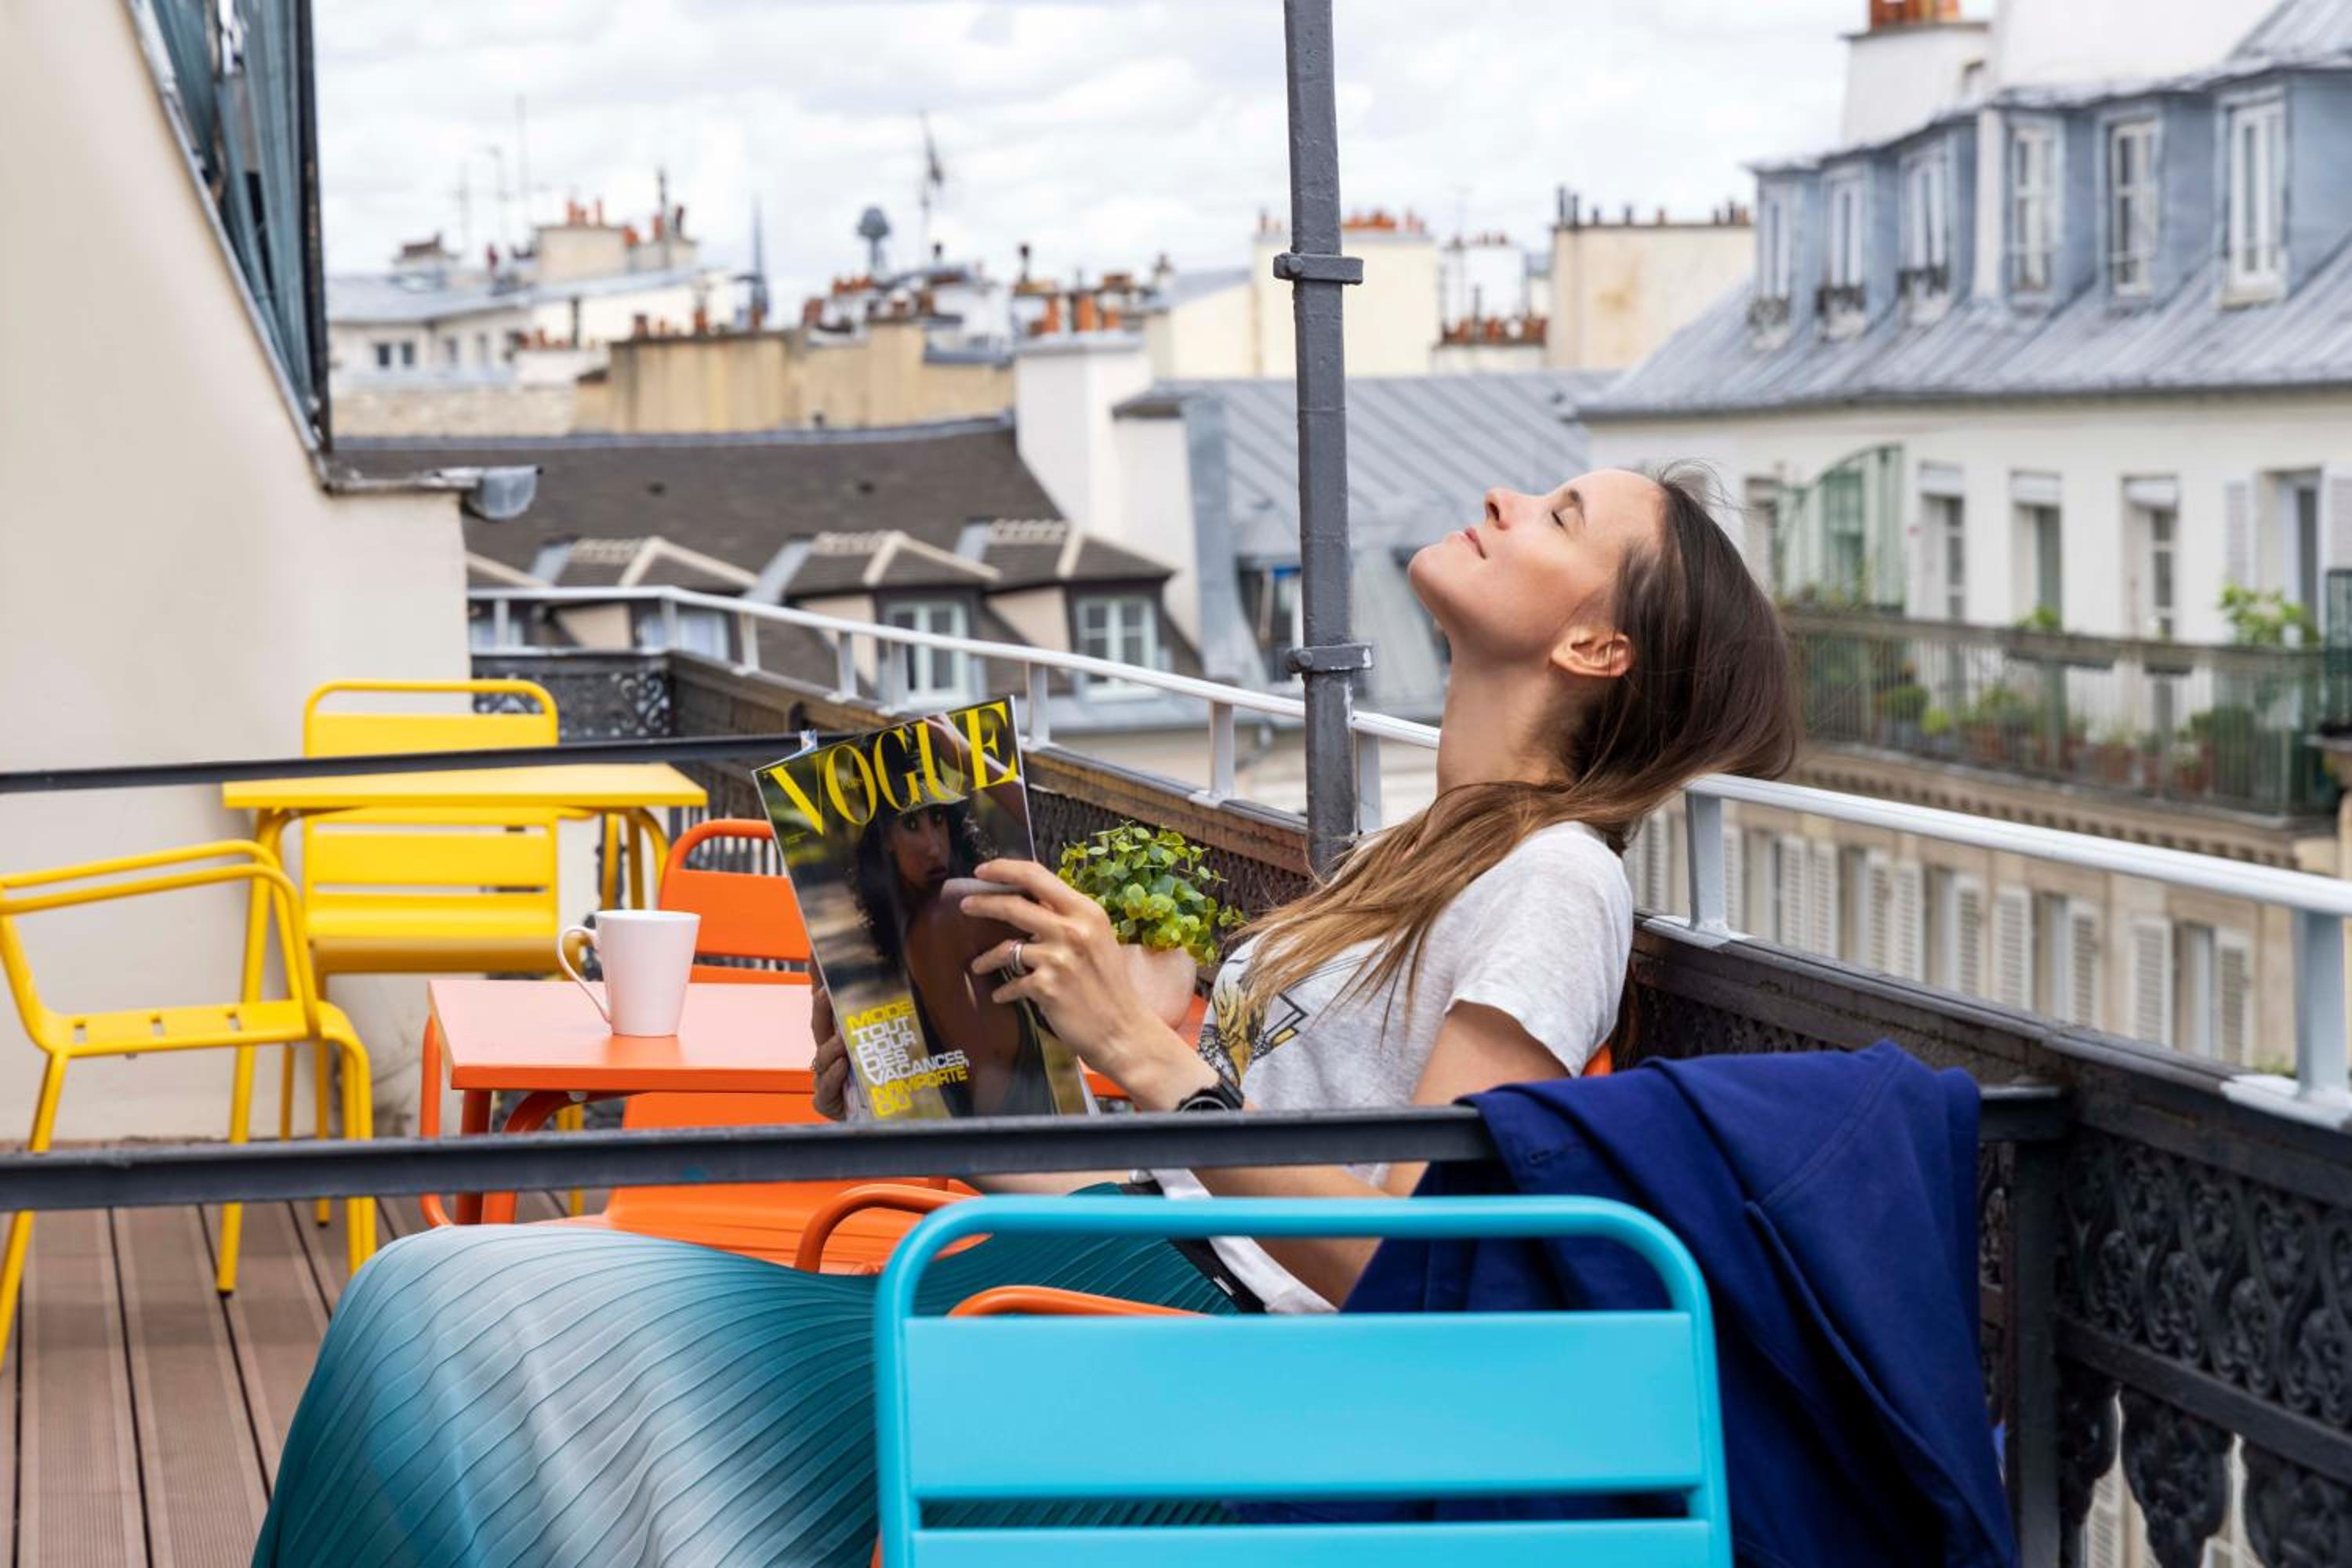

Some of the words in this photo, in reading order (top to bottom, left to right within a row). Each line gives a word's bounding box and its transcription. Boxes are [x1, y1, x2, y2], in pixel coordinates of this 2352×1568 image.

[768, 702, 1018, 836] VOGUE
[846, 1001, 915, 1029] MODE
[851, 1016, 909, 1044] TOUT
[856, 1030, 916, 1057] POUR
[862, 1048, 910, 1074] DES
[865, 1050, 970, 1085] VACANCES,
